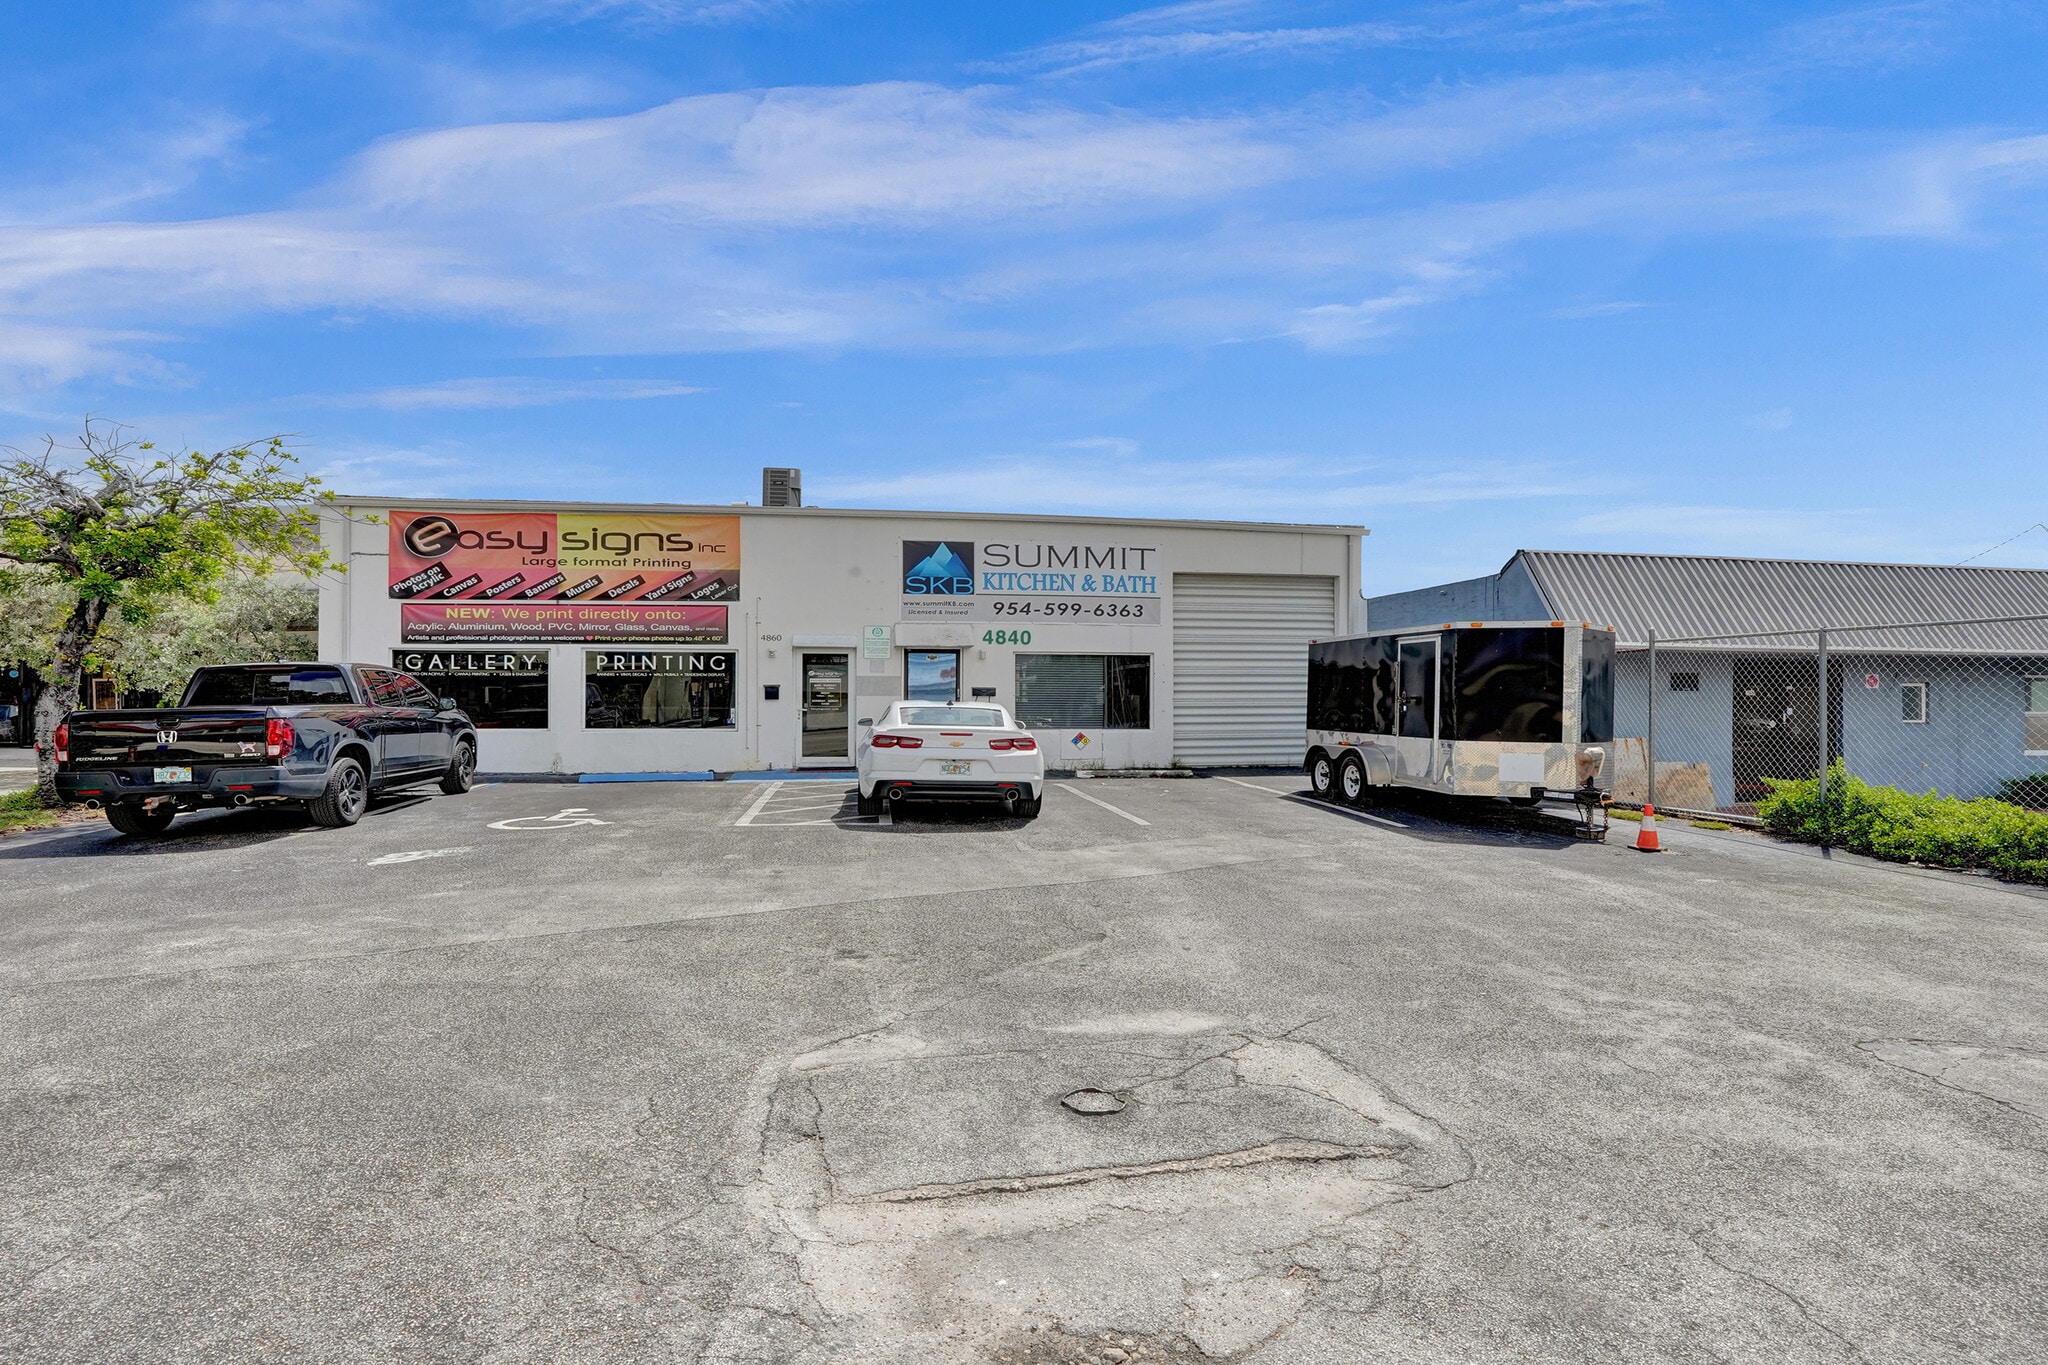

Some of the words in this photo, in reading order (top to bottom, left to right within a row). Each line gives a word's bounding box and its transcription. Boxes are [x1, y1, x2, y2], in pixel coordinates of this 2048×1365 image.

[409, 519, 549, 556] easy
[562, 528, 694, 556] signs
[522, 556, 568, 568] Large
[573, 556, 628, 567] format
[634, 557, 691, 569] Printing
[982, 543, 1157, 571] SUMMIT
[393, 570, 427, 592] Photos
[427, 565, 441, 577] on
[412, 573, 445, 593] Acrylic
[443, 577, 478, 597] Canvas
[485, 575, 522, 597] Posters
[524, 574, 565, 598] Banners
[565, 578, 599, 598] Murals
[645, 584, 669, 601] Yard
[667, 574, 693, 591] Signs
[905, 576, 974, 595] SKB
[982, 572, 1075, 592] KITCHEN
[1080, 575, 1097, 593] &
[1102, 574, 1157, 594] BATH
[607, 579, 640, 598] Decals
[691, 582, 720, 600] Logos
[711, 589, 726, 600] Laser
[446, 608, 495, 619] NEW:
[501, 608, 530, 619] We
[536, 608, 573, 621] print
[579, 609, 640, 622] directly
[645, 610, 686, 620] onto:
[993, 601, 1144, 618] 954-599-6363
[407, 622, 446, 632] Acrylic,
[448, 622, 507, 632] Aluminium,
[510, 623, 545, 632] Wood,
[548, 622, 576, 632] PVC,
[579, 623, 612, 632] Mirror,
[614, 623, 648, 632] Glass,
[650, 623, 693, 632] Canvas,
[445, 634, 489, 642] professional
[489, 634, 540, 643] photographers
[612, 635, 627, 643] your
[628, 635, 650, 643] phone
[651, 635, 674, 643] photos
[982, 629, 1032, 645] 4840
[405, 654, 537, 670] GALLERY
[596, 655, 726, 670] PRINTING
